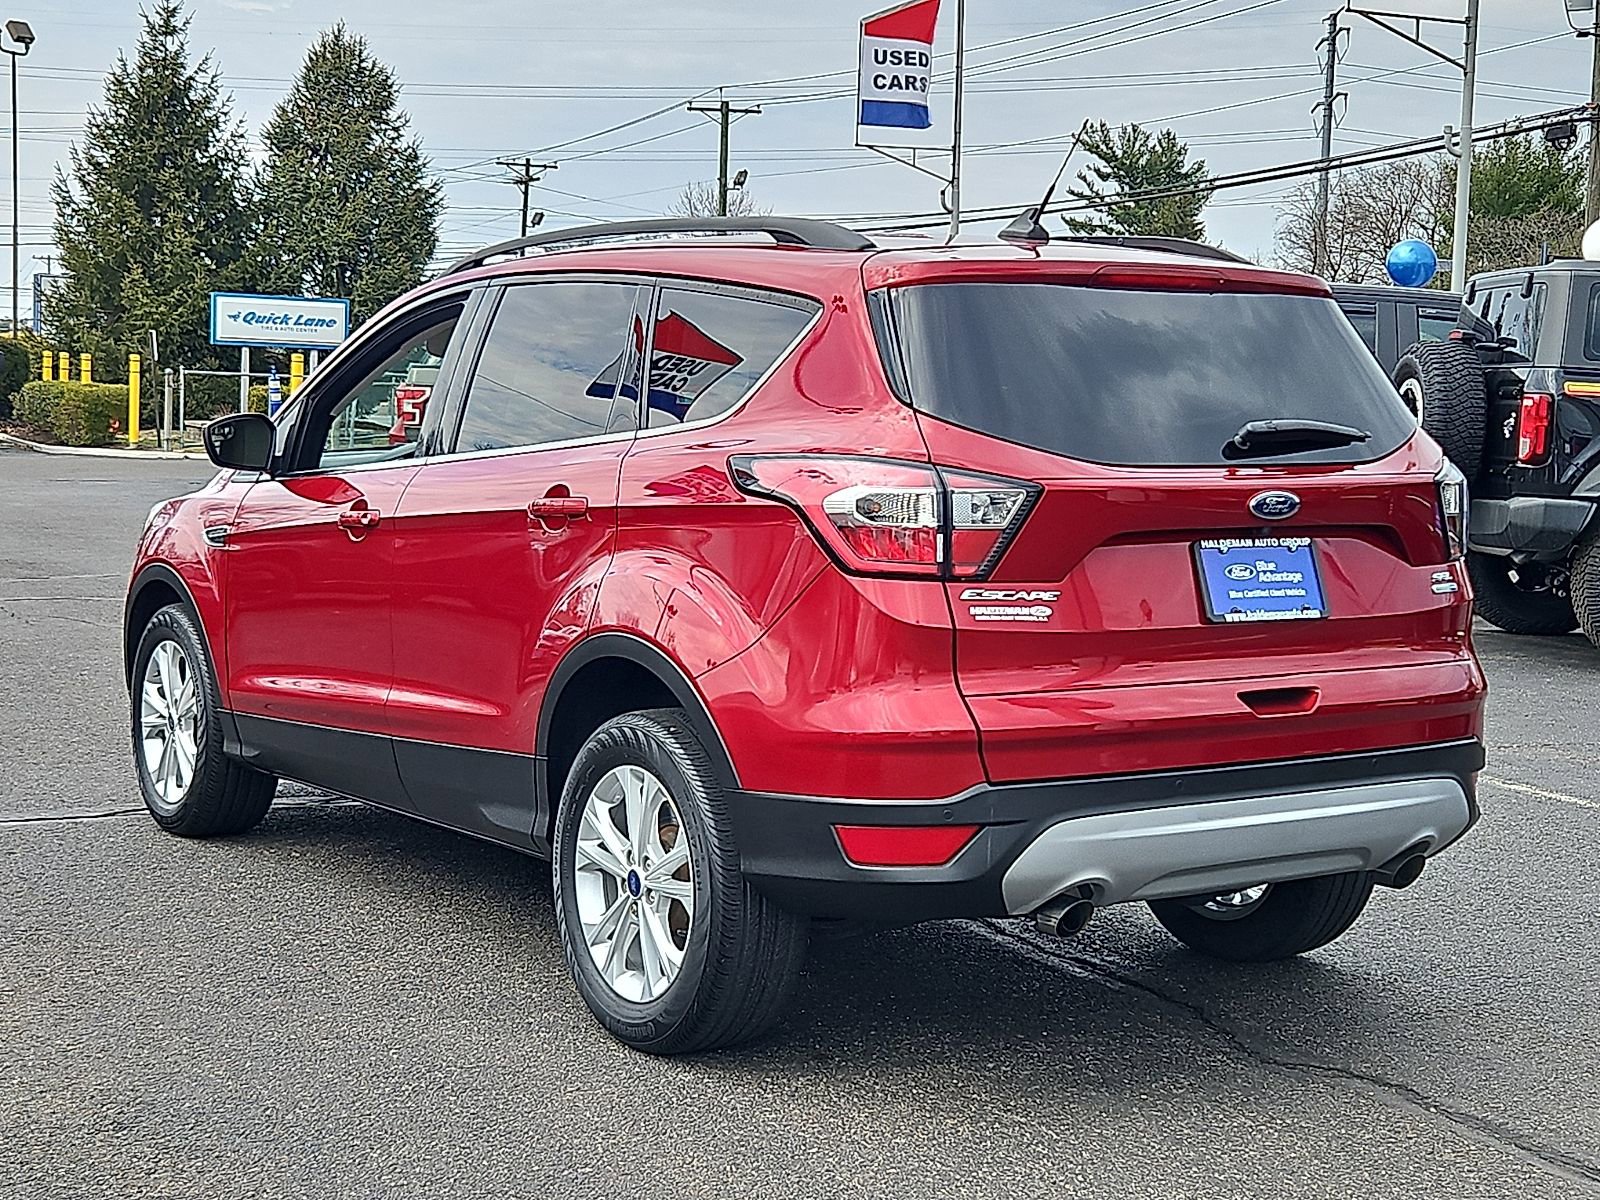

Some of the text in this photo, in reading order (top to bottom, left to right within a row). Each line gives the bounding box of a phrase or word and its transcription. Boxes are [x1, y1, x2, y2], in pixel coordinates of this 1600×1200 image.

[873, 48, 930, 68] USED
[873, 73, 929, 93] CARS
[243, 311, 337, 327] Quick Lane
[1262, 497, 1291, 513] Ford
[1201, 538, 1311, 549] HALDEMAN AUTO GROUP
[1255, 560, 1277, 571] Blue
[1258, 572, 1304, 583] Advantage
[960, 588, 1061, 601] ESCAPE
